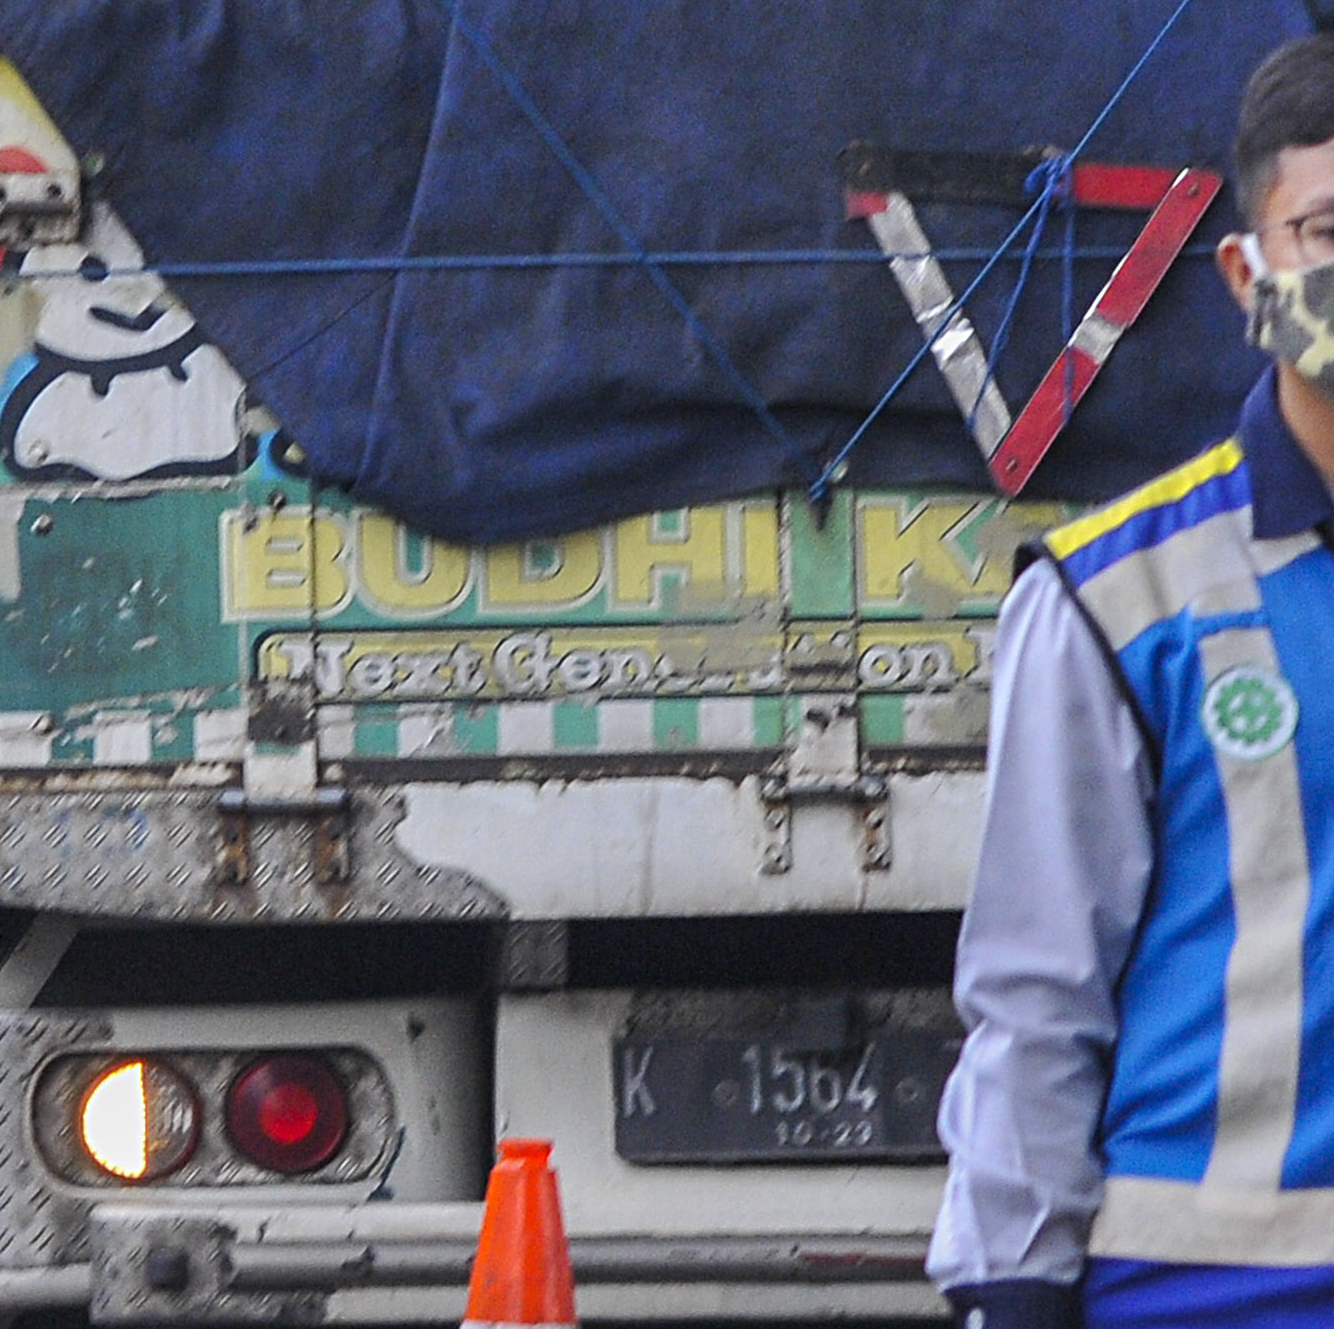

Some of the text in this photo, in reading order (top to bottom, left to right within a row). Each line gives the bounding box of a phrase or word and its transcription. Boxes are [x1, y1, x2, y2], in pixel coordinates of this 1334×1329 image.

[219, 493, 791, 623] BUDHI
[621, 1039, 880, 1118] K 1564
